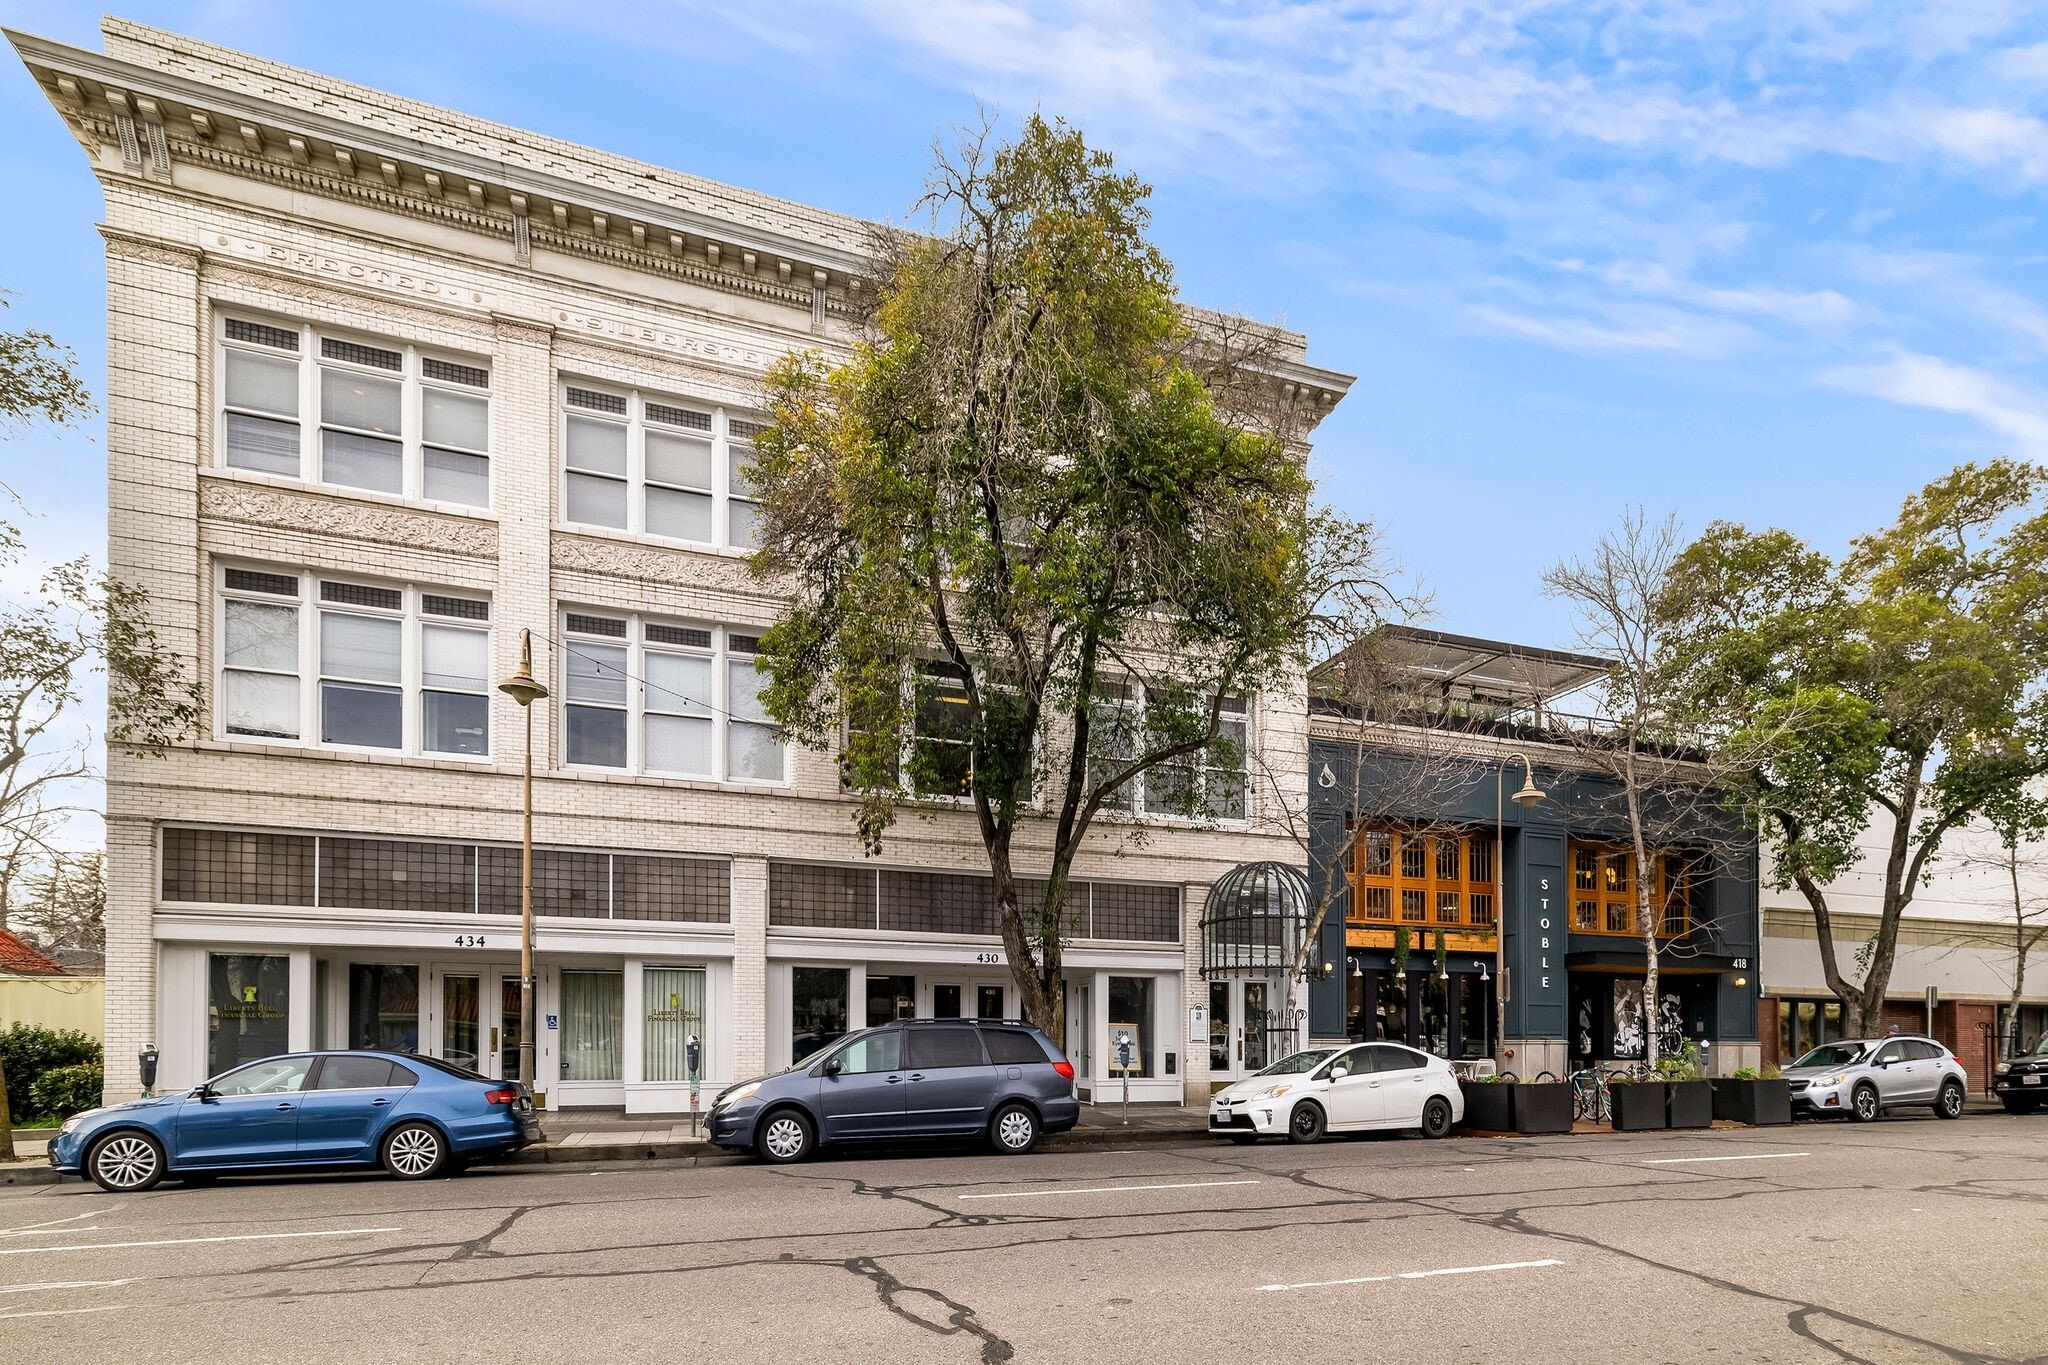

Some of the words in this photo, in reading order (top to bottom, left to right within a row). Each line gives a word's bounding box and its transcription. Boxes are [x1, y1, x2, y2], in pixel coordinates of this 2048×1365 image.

[267, 246, 440, 295] ERECTED
[587, 318, 777, 367] SILBERSTEI
[454, 935, 486, 947] 434
[1540, 878, 1550, 988] STOBLE
[976, 953, 999, 964] 430
[1732, 958, 1747, 969] 418
